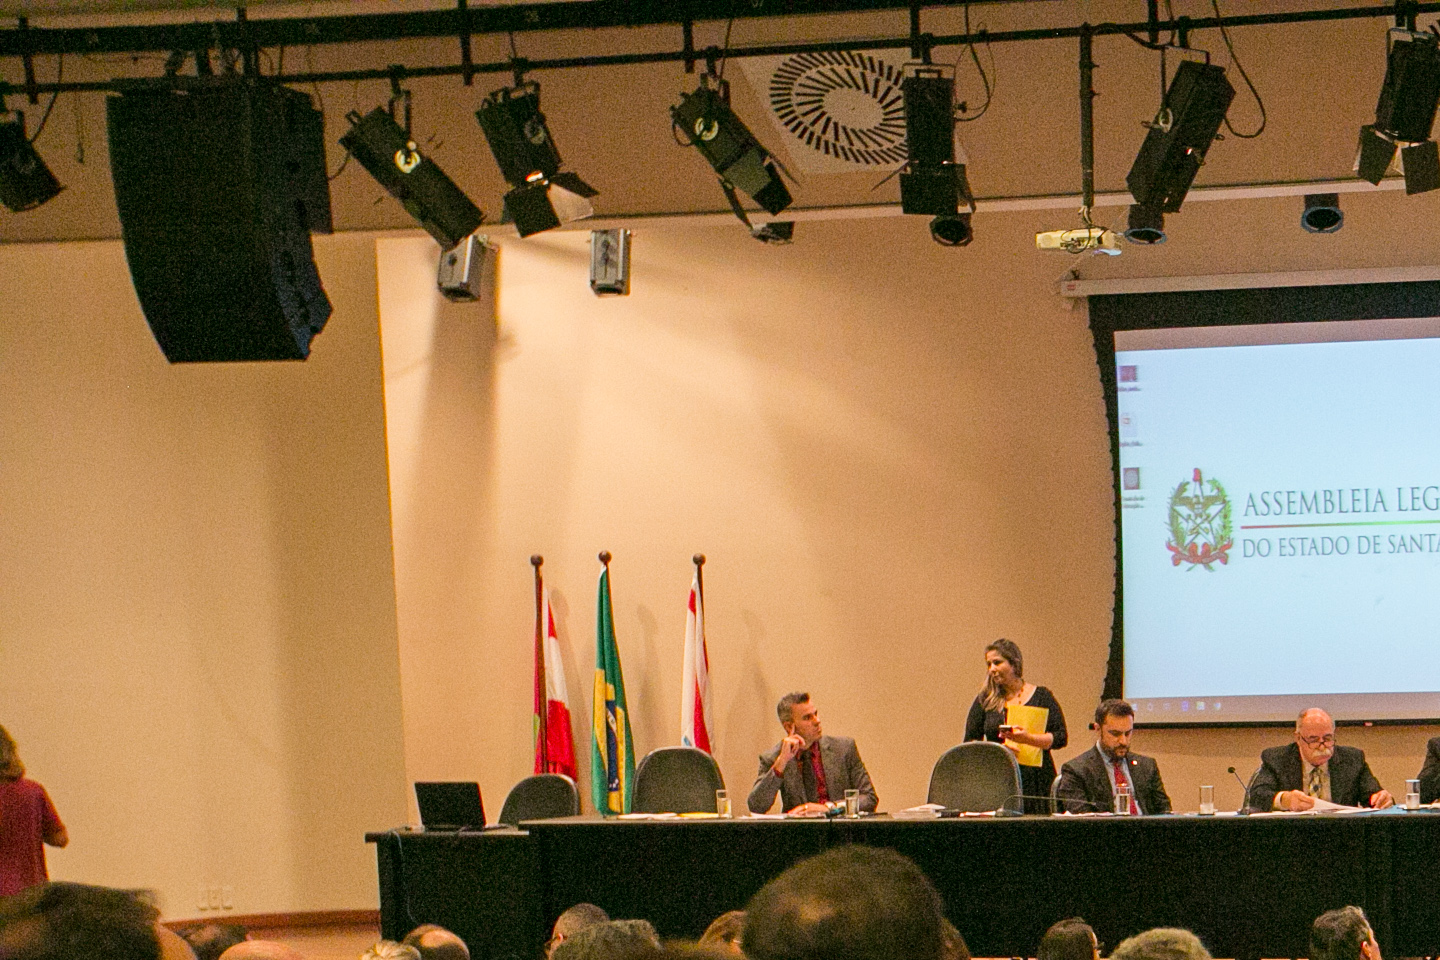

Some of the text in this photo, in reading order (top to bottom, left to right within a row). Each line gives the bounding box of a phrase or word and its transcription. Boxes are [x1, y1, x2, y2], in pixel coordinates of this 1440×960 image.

[1243, 488, 1388, 516] ASSEMBLEIA
[1243, 537, 1271, 557] DO
[1278, 536, 1350, 557] ESTADO
[1357, 535, 1381, 555] DE
